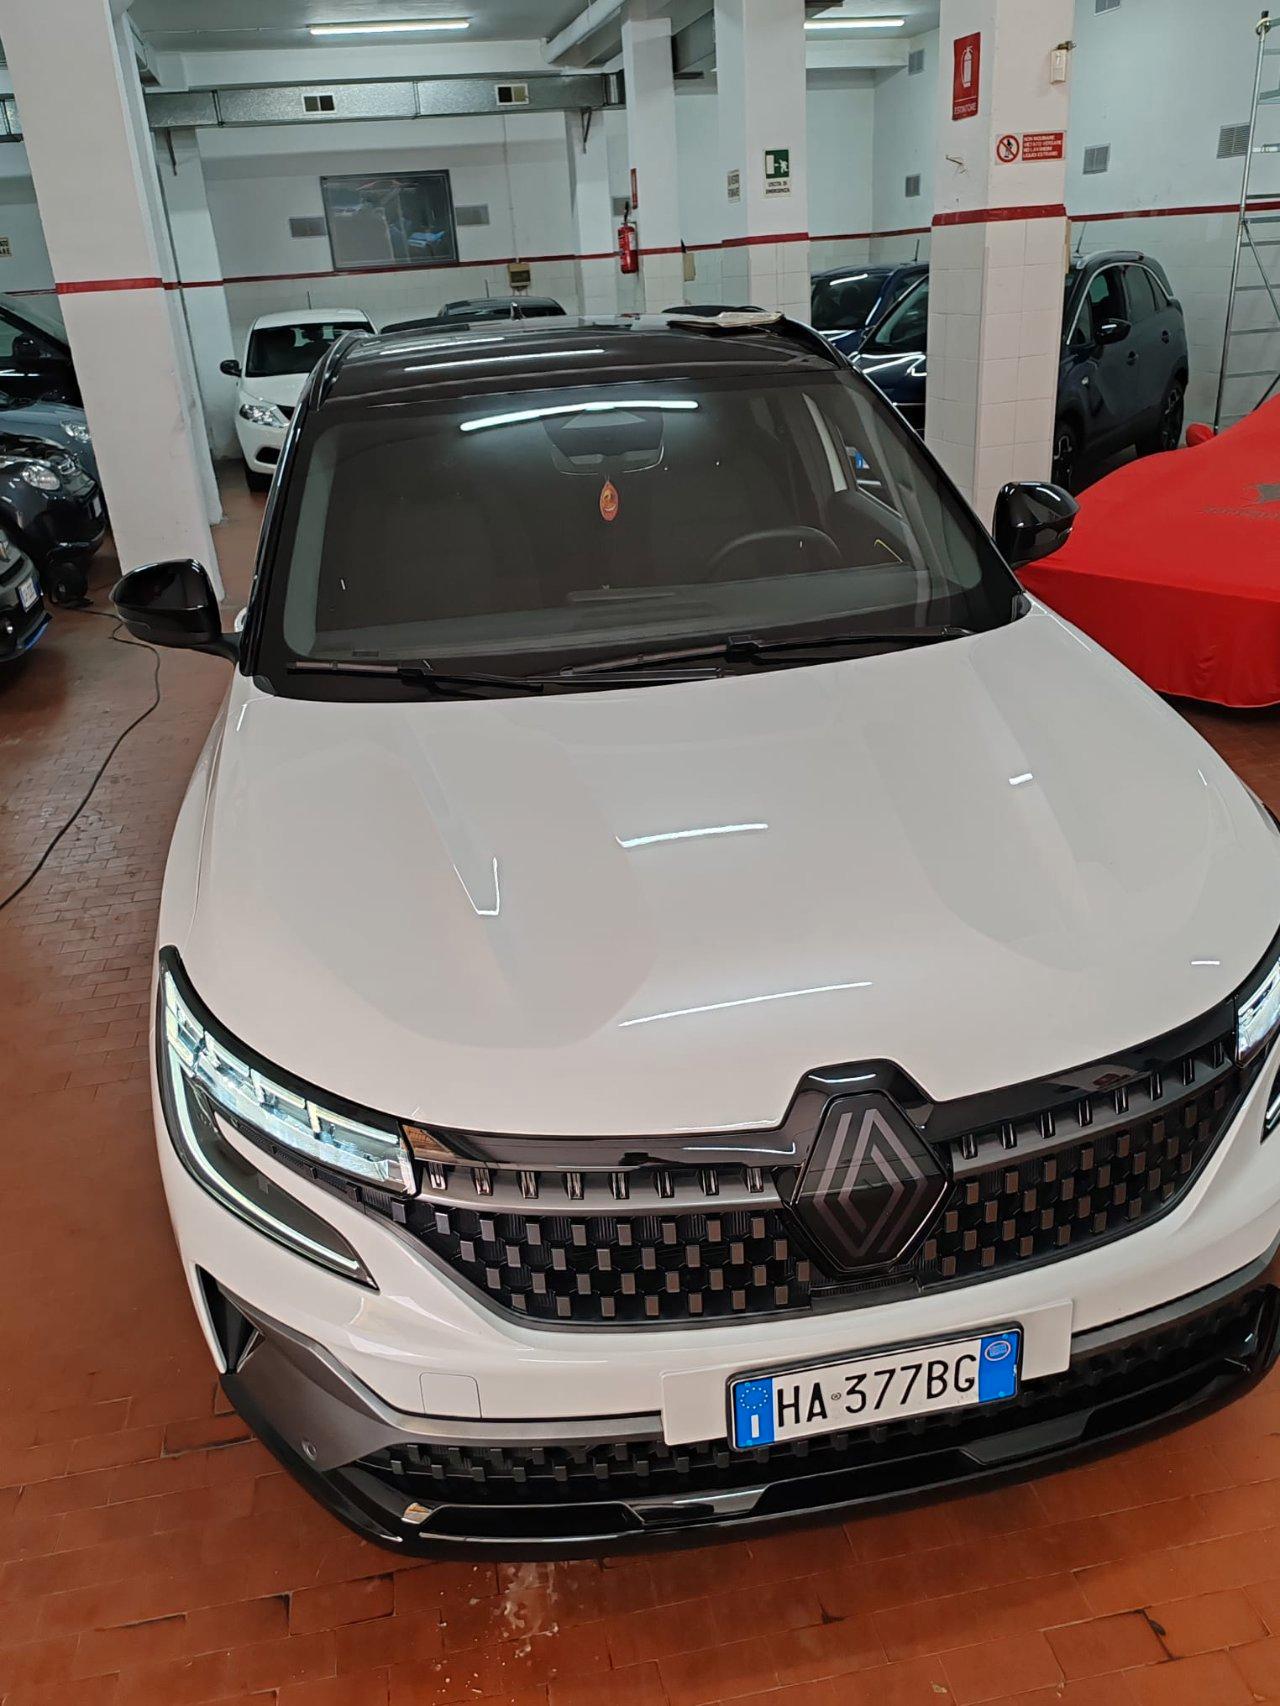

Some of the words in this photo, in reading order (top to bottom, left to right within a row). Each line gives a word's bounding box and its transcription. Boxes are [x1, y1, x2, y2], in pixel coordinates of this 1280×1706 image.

[776, 1382, 828, 1428] HA
[844, 1354, 977, 1414] 377BG
[751, 1414, 760, 1438] I
